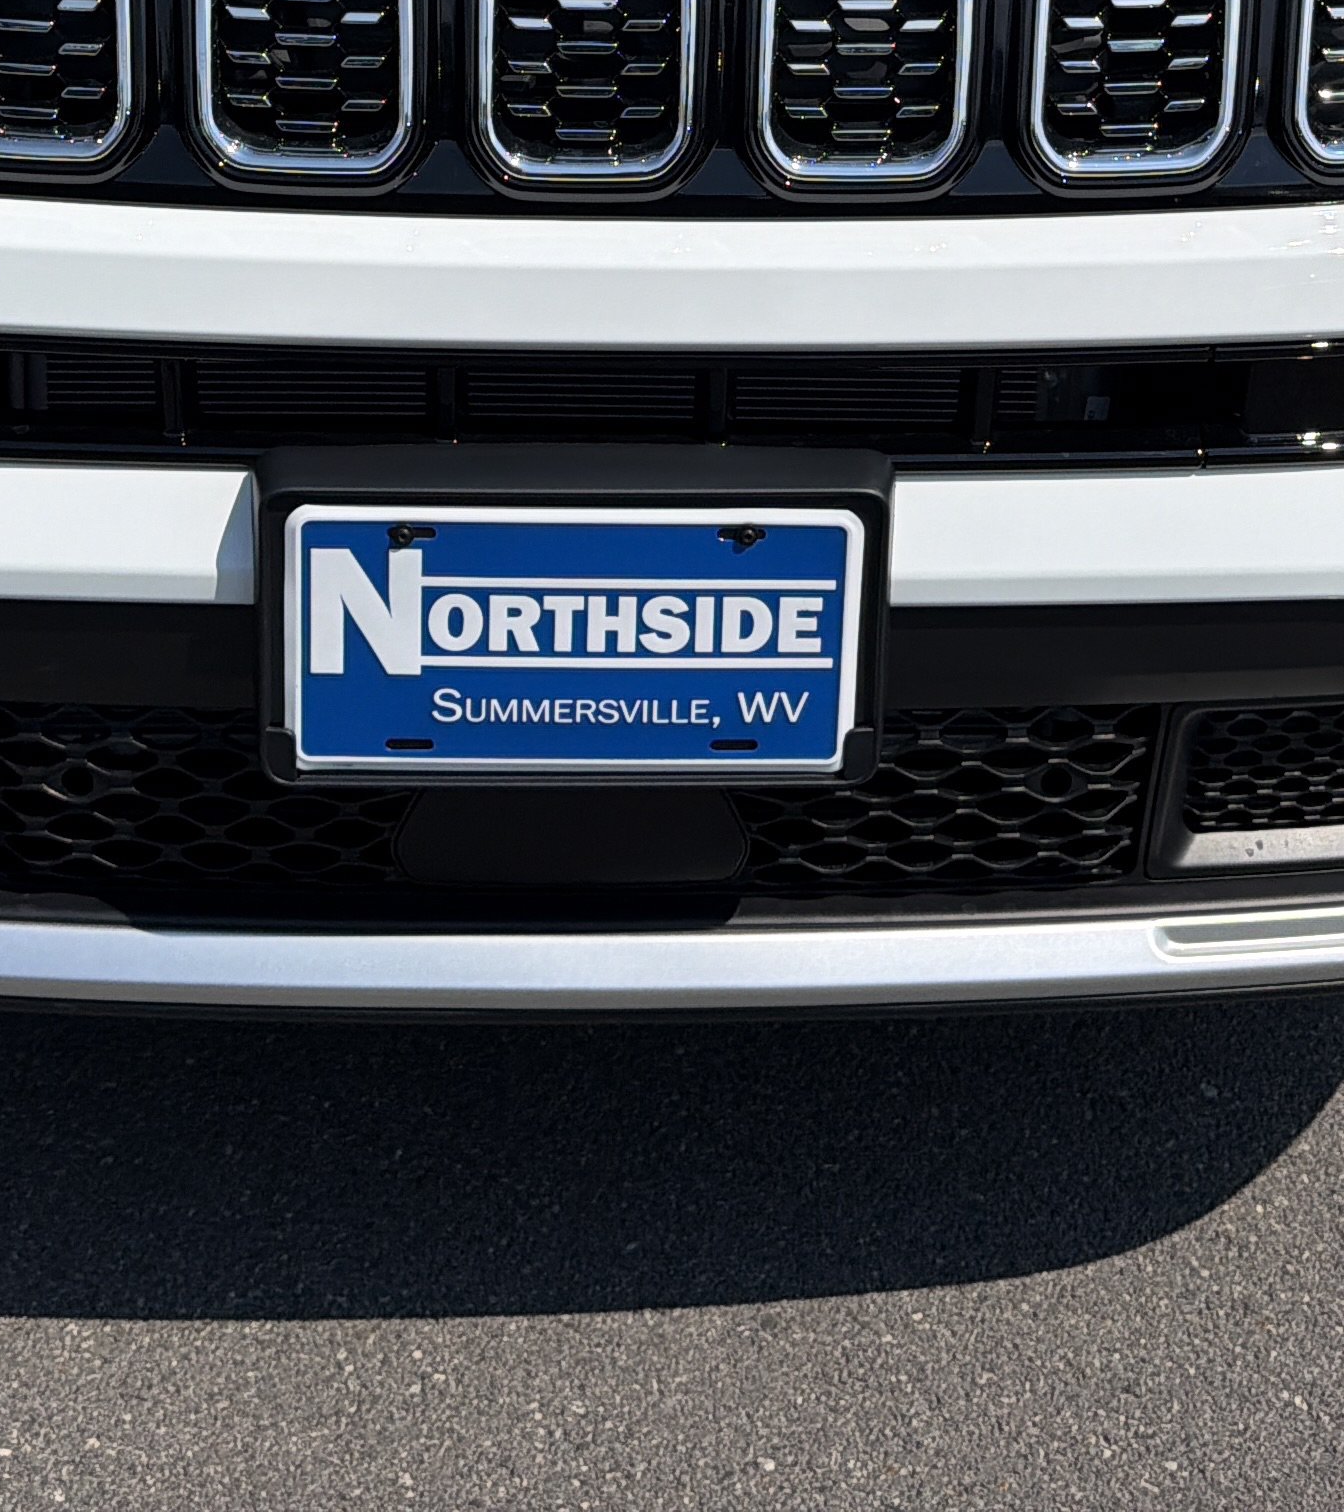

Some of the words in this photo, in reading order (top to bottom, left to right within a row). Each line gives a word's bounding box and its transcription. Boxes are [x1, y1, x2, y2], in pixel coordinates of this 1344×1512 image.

[309, 547, 824, 676] NORTHSIDE
[431, 687, 722, 729] SUMMERSVILLE,
[737, 691, 810, 724] WV
